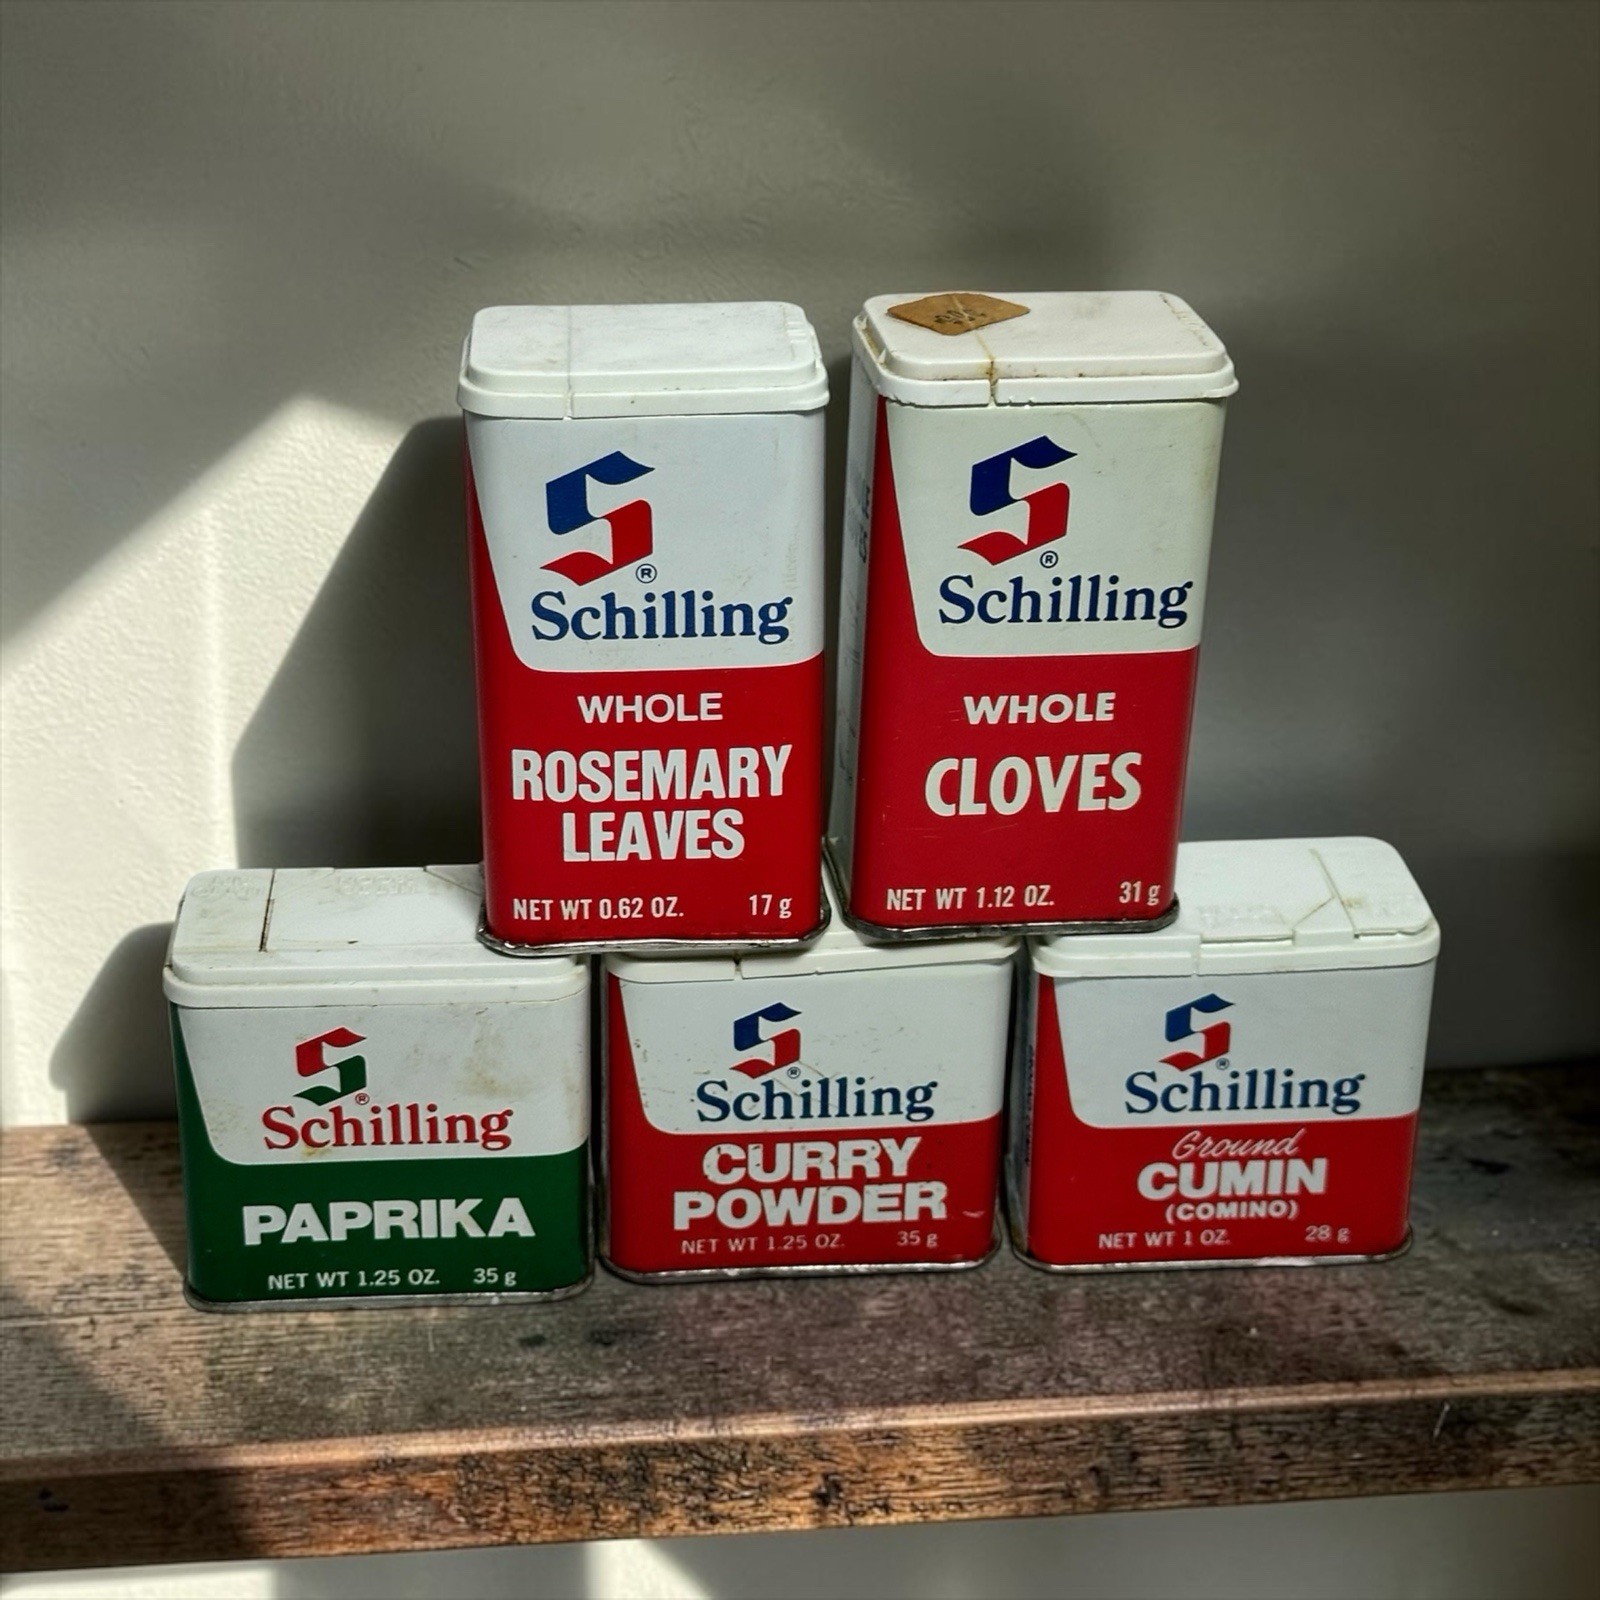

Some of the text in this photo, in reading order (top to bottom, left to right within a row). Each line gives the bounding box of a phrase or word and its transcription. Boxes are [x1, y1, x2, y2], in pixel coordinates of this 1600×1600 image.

[531, 590, 794, 645] Schilling
[938, 574, 1194, 630] Schilling
[576, 692, 723, 724] WHOLE
[963, 691, 1116, 725] WHOLE
[511, 744, 793, 803] ROSEMARY
[924, 751, 1142, 817] CLOVES
[562, 808, 745, 863] LEAVES
[513, 896, 684, 921] NET WT 0.62 OZ.
[749, 894, 792, 919] 17 g
[886, 884, 1055, 911] NET WT 1.12 OZ.
[1119, 880, 1161, 907] 31 g
[696, 1076, 938, 1122] Schilling
[1124, 1067, 1366, 1116] Schilling
[261, 1102, 515, 1151] Schilling
[1171, 1127, 1306, 1159] Ground
[702, 1136, 922, 1185] CURRY
[1137, 1157, 1328, 1201] CUMIN
[242, 1197, 536, 1246] PAPRIKA
[673, 1180, 948, 1231] POWDER
[1165, 1199, 1299, 1225] (COMINO)
[681, 1233, 845, 1254] NET WT 1.25 OZ.
[897, 1229, 938, 1249] 35 g
[1098, 1228, 1231, 1249] NET WT 1 OZ.
[1305, 1224, 1350, 1244] 28 g
[268, 1268, 440, 1290] NET WT 1.25 OZ.
[473, 1267, 517, 1287] 35 g
